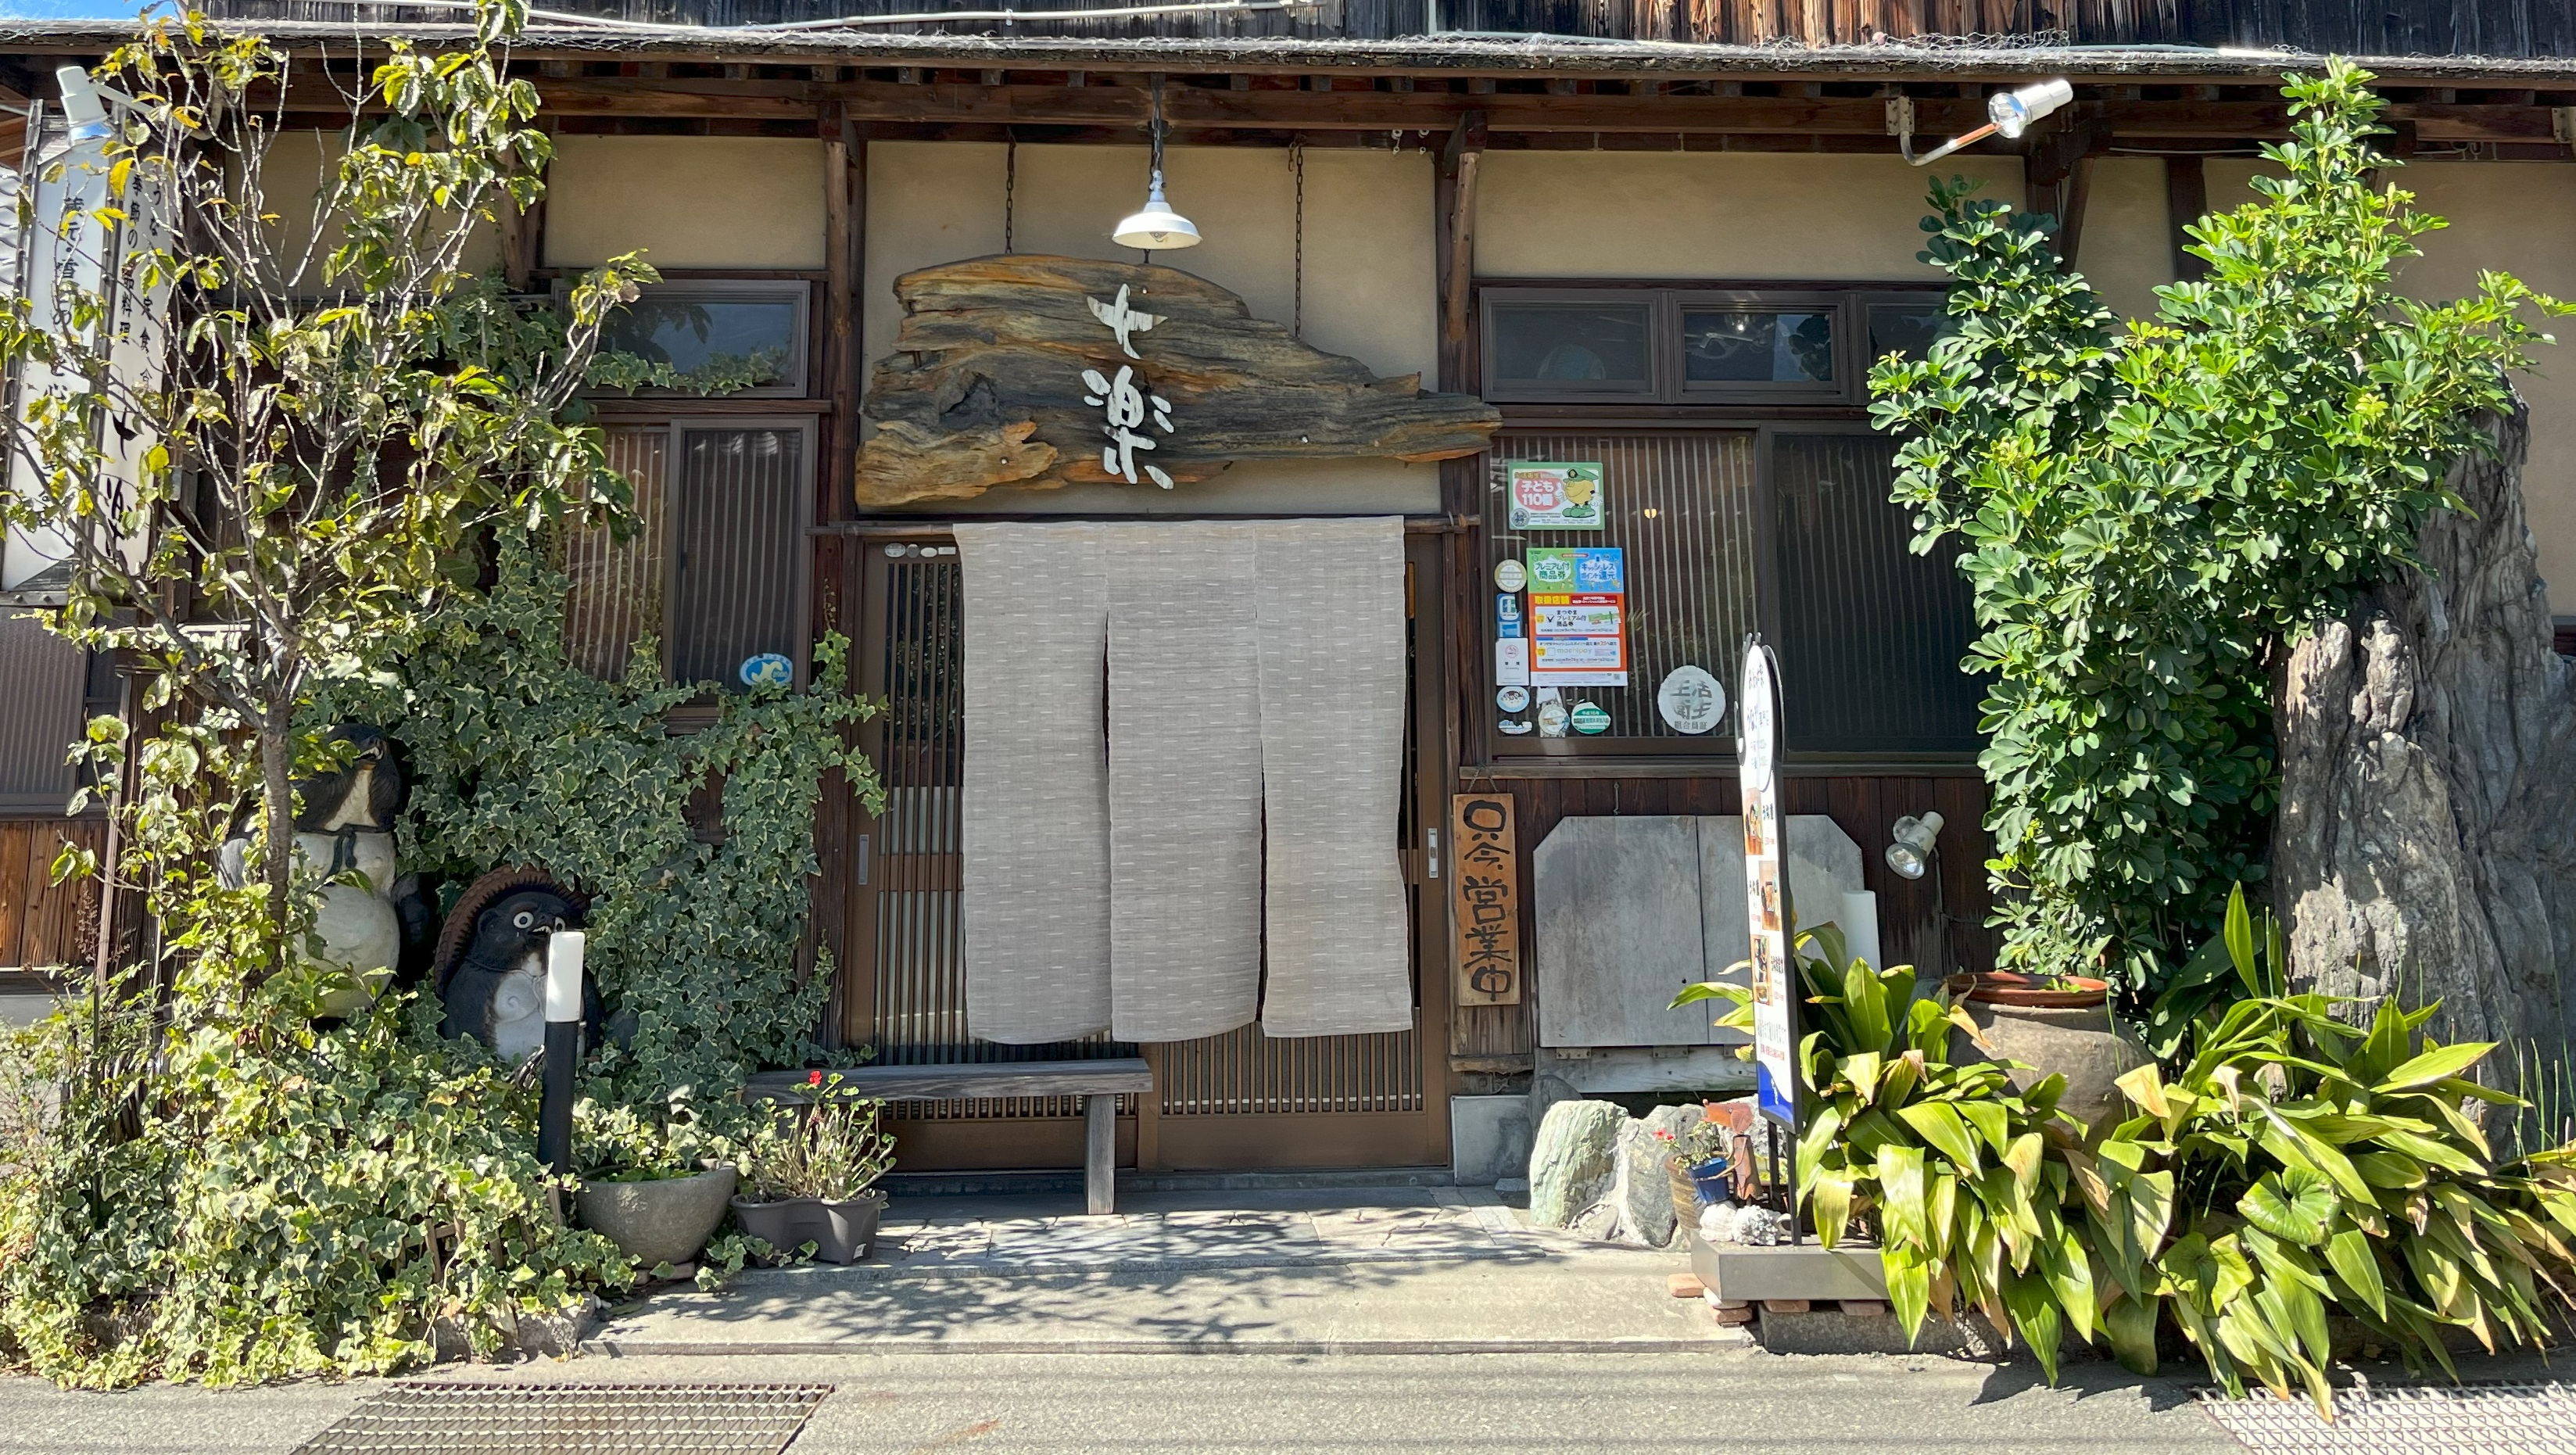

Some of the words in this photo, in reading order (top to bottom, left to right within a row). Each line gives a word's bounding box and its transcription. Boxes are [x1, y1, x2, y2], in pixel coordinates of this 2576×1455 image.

[1521, 480, 1554, 493] 子ども
[1521, 493, 1553, 507] 110番
[1535, 562, 1571, 571] プレミアム付
[1539, 571, 1566, 580] 商品券
[1674, 720, 1708, 730] 組合員証
[1463, 800, 1513, 1003] 只今営業中
